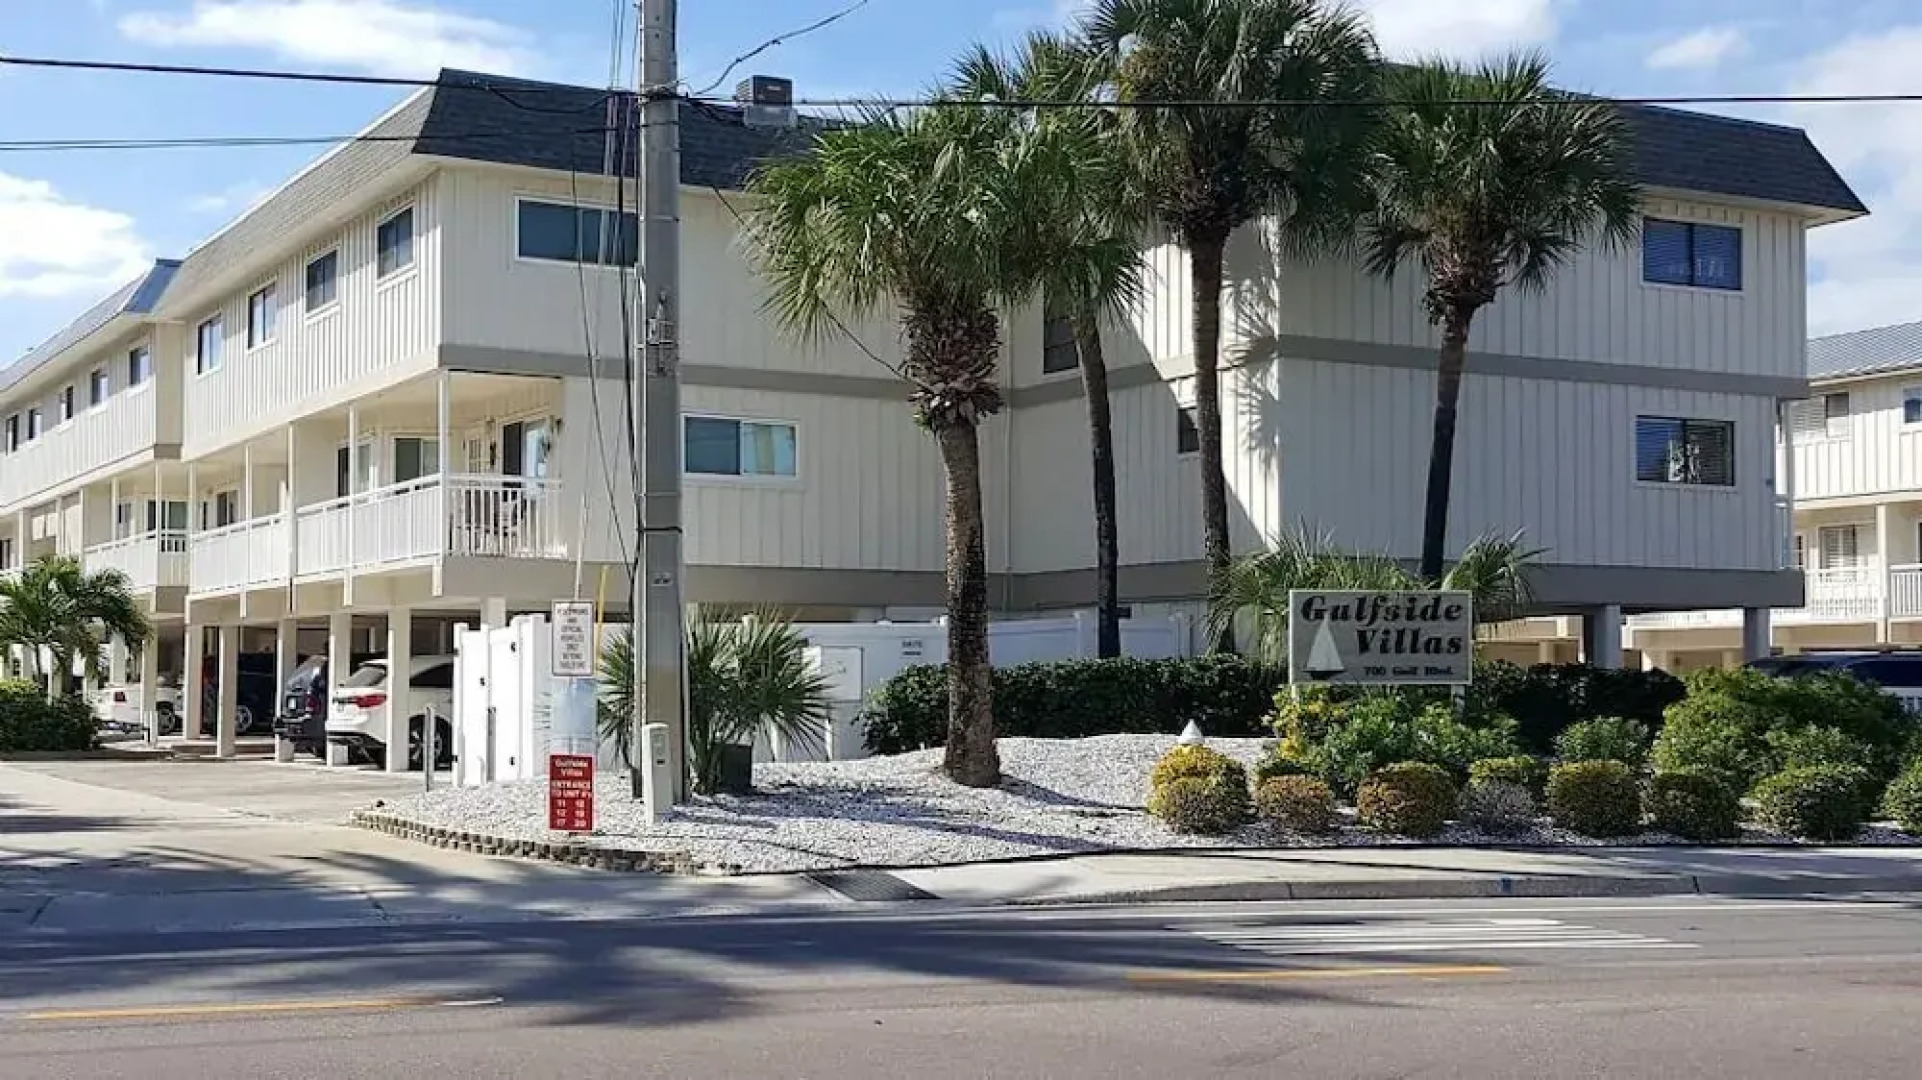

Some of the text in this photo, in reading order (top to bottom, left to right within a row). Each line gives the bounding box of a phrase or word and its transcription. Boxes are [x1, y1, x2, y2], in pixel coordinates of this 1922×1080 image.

[1301, 595, 1462, 626] Gulfside
[1356, 628, 1462, 654] Villas
[1363, 666, 1387, 676] 700
[561, 768, 583, 777] Villas
[551, 780, 591, 789] ENTRANCE
[562, 789, 580, 798] UNIT
